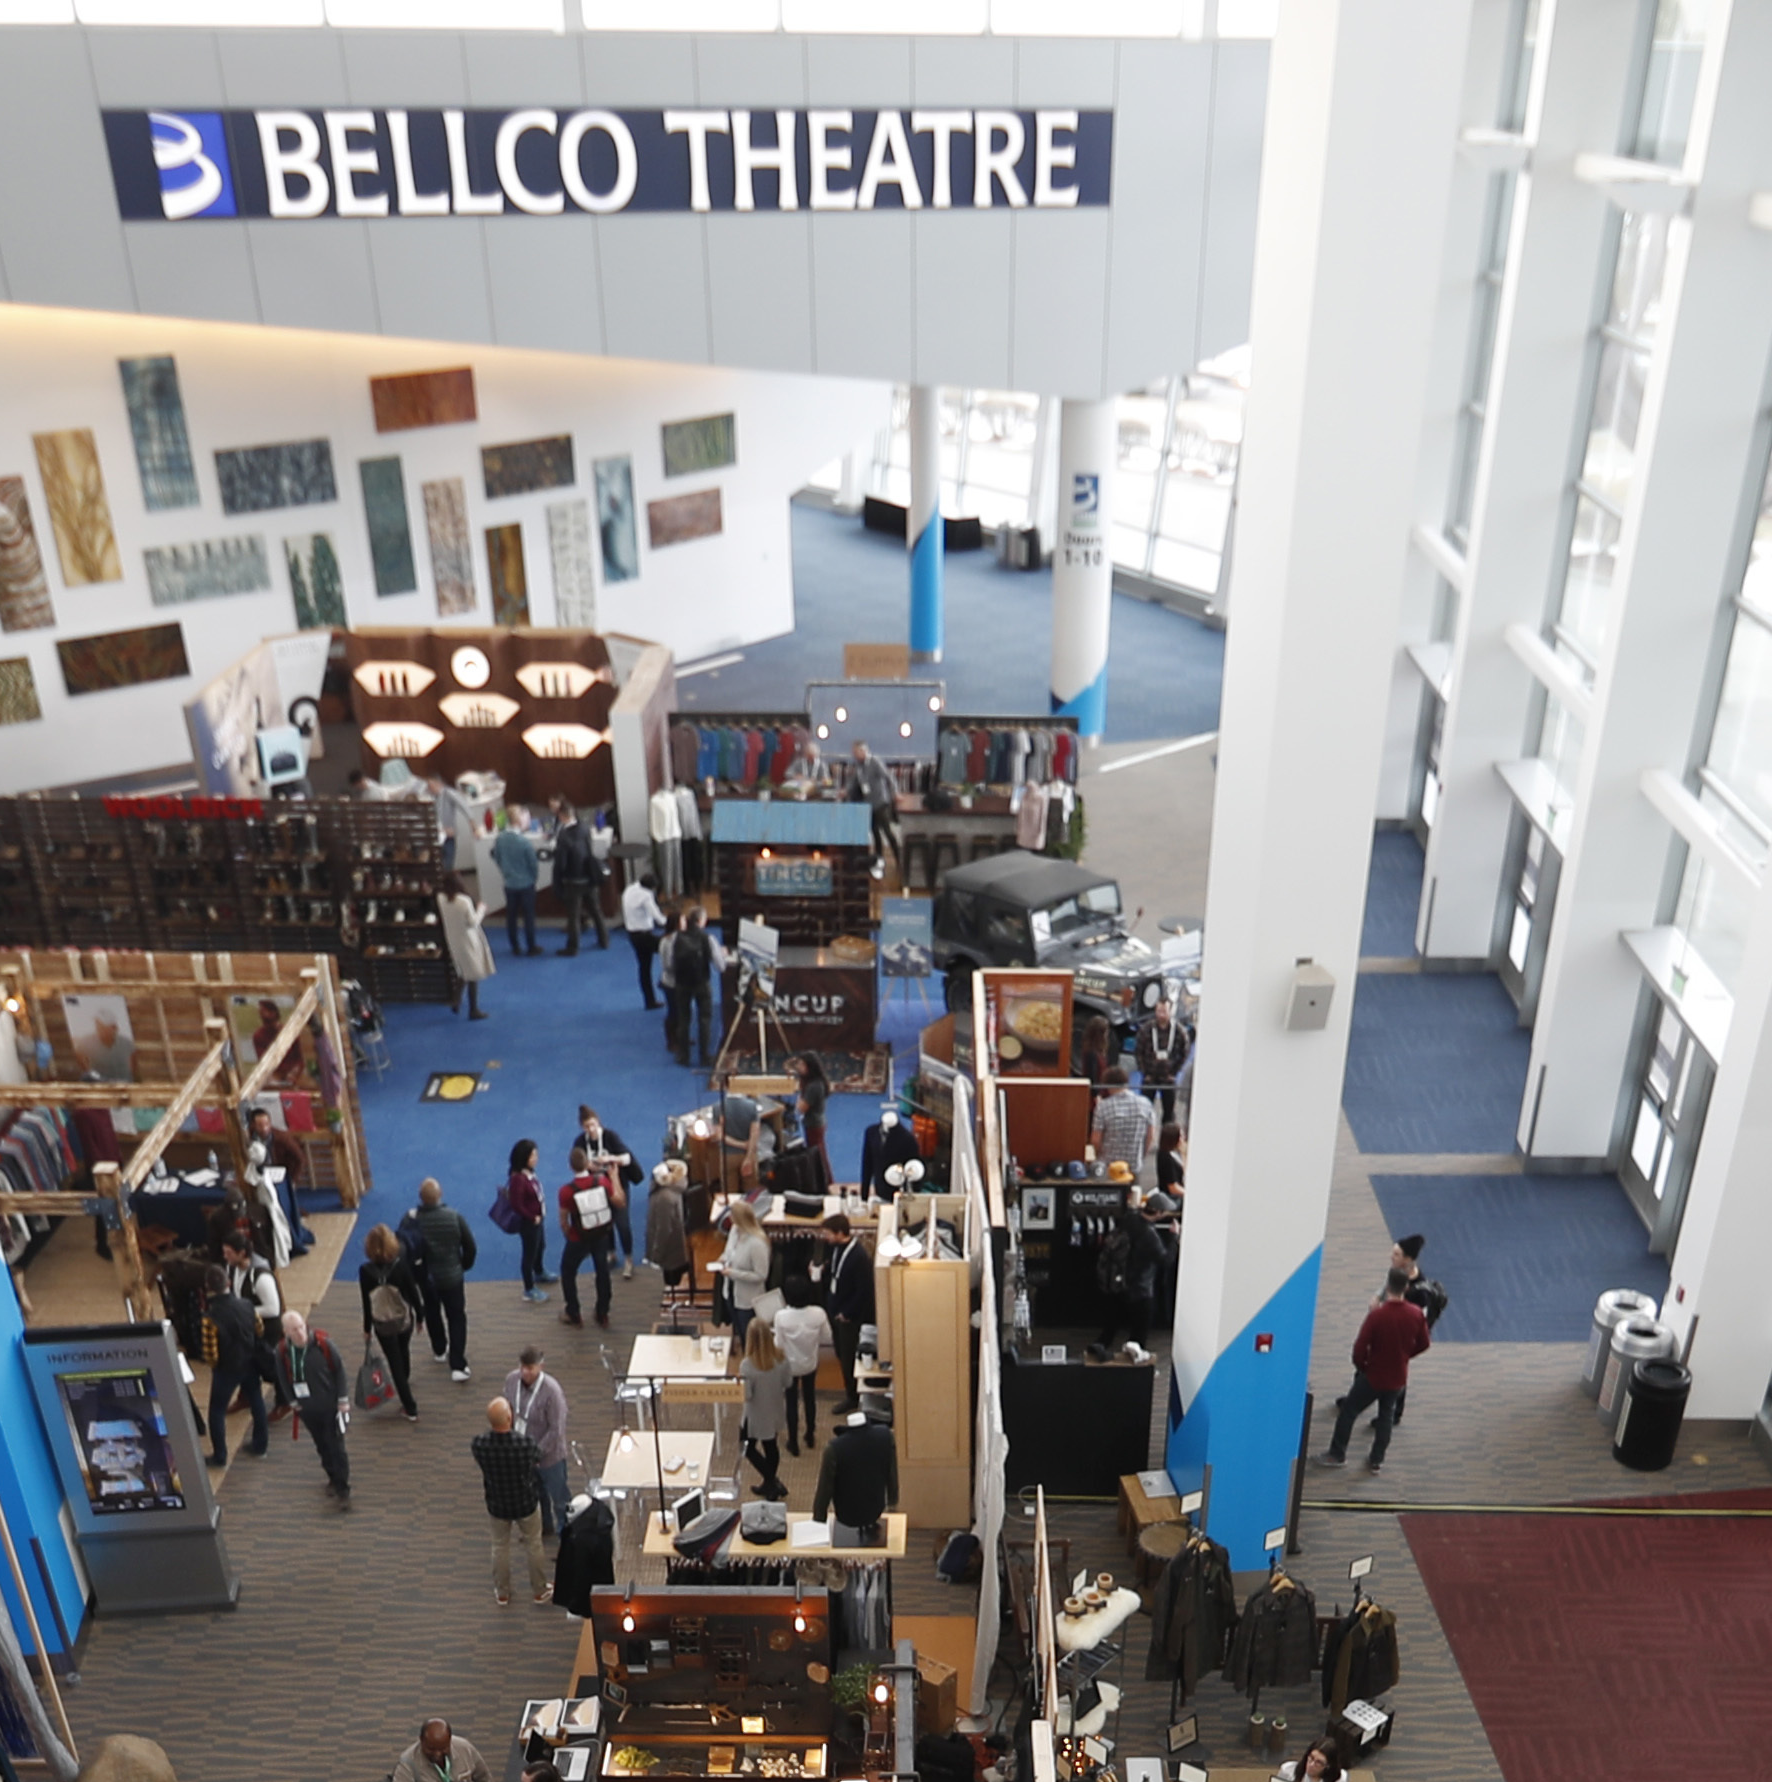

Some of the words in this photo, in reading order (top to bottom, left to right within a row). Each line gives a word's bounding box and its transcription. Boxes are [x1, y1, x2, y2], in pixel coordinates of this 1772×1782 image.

[254, 108, 639, 220] BELLCO
[662, 108, 1081, 212] THEATRE
[100, 793, 264, 820] WOOLRICH
[46, 1348, 149, 1364] INFORMATION
